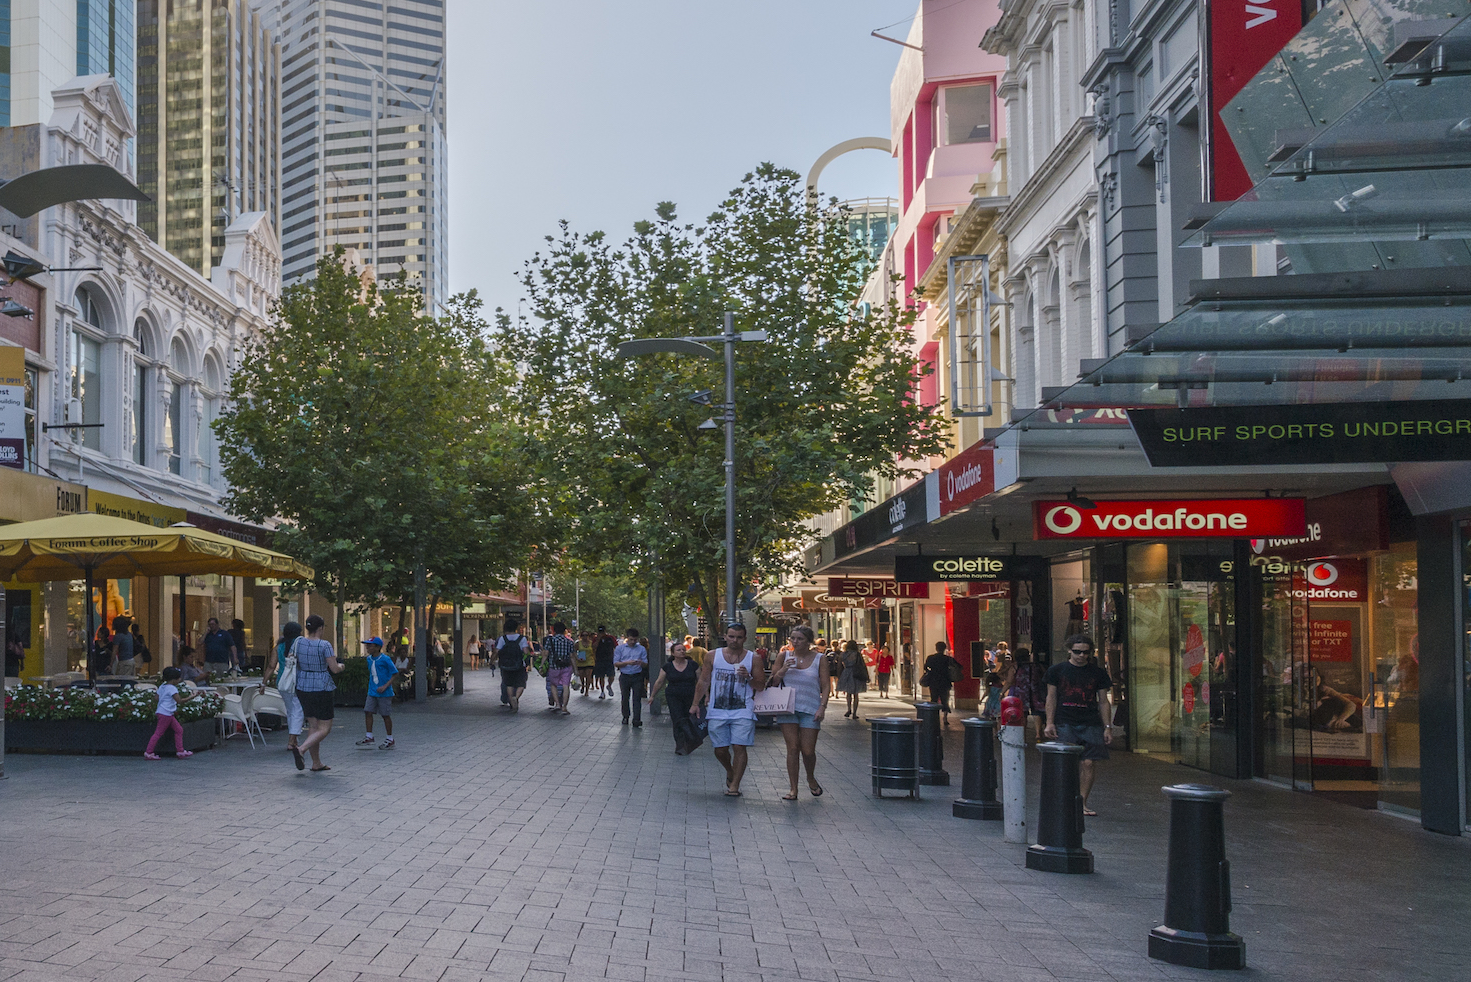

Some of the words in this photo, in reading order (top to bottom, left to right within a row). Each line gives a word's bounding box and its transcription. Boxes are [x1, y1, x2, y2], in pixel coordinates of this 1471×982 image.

[1162, 427, 1227, 442] SURF
[1235, 423, 1335, 440] SPORTS
[954, 462, 982, 494] vodafone
[56, 486, 81, 513] FORUM
[95, 502, 121, 517] Welcome
[121, 508, 127, 519] to
[127, 509, 136, 520] the
[136, 510, 151, 525] Optus
[1092, 508, 1247, 531] vodafone
[90, 537, 127, 548] Coffee
[130, 536, 158, 548] Shop
[932, 557, 1004, 572] colette
[842, 580, 915, 596] ESPRIT
[1285, 587, 1358, 599] vodafone
[1314, 630, 1348, 638] Infinite
[753, 703, 787, 711] REVIEW
